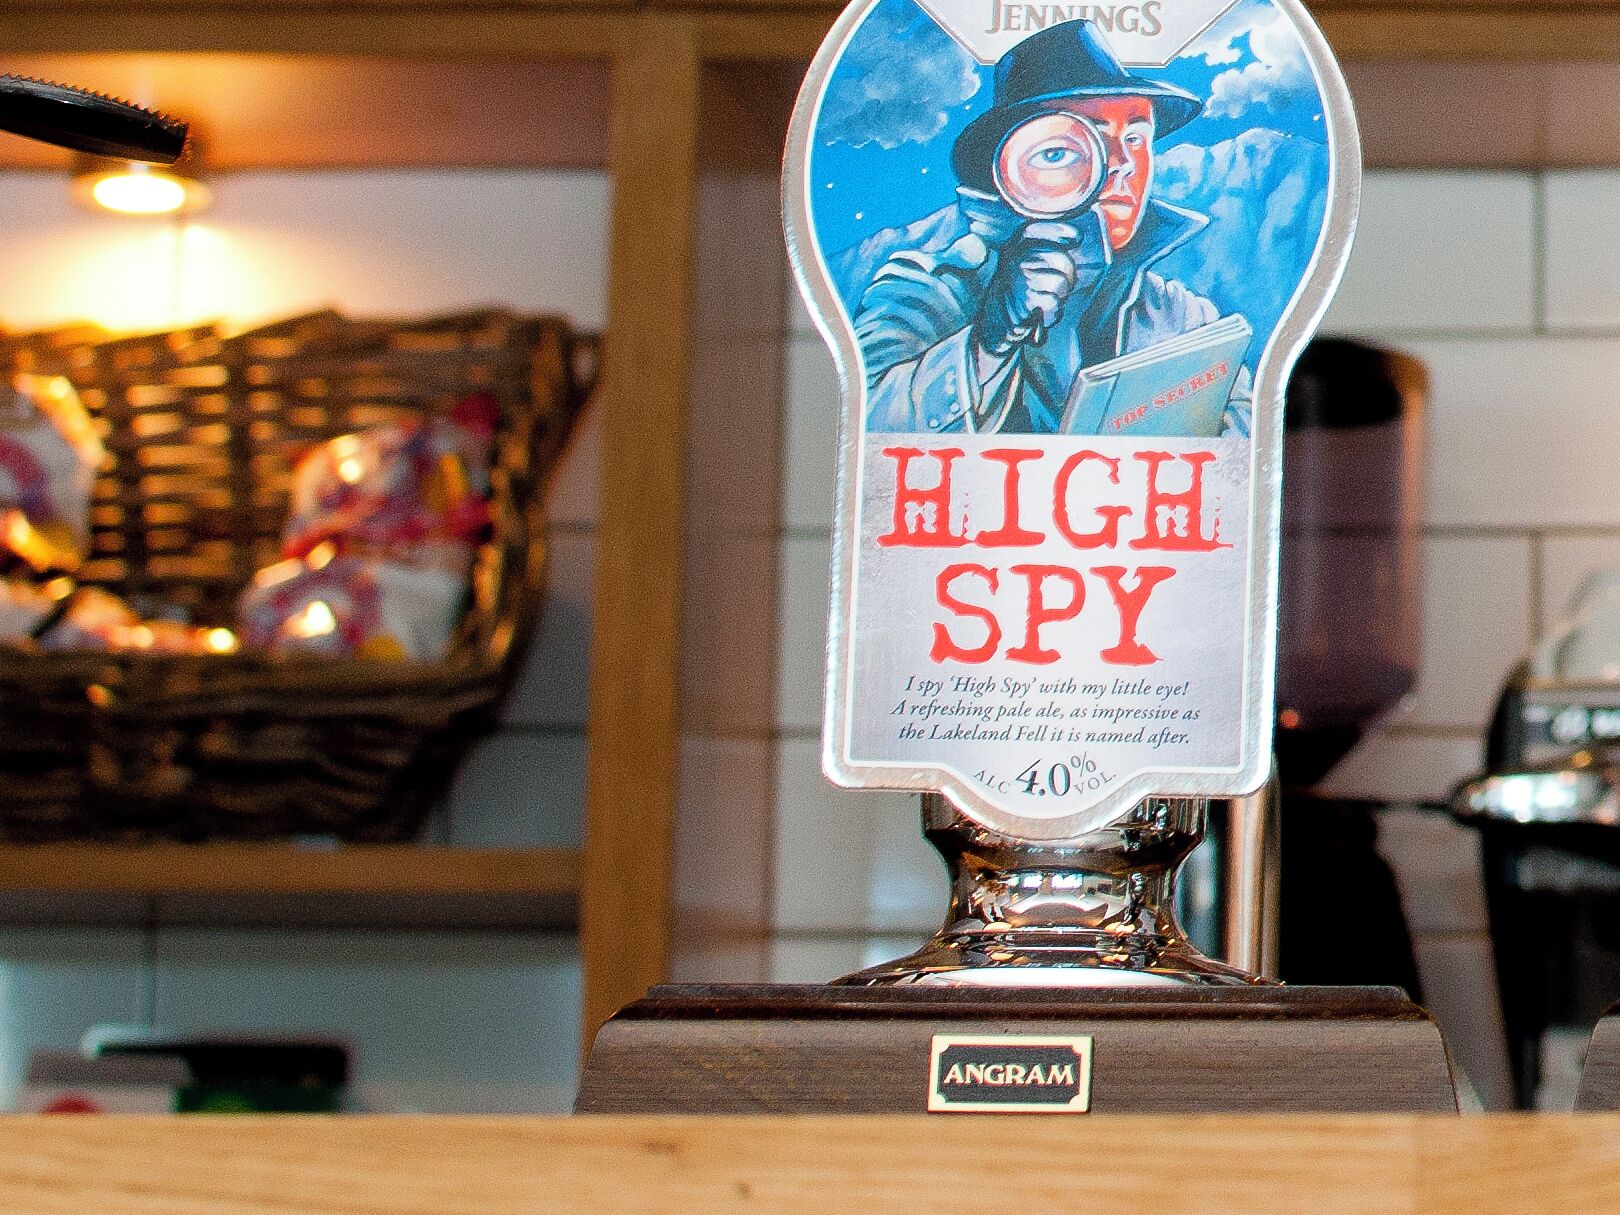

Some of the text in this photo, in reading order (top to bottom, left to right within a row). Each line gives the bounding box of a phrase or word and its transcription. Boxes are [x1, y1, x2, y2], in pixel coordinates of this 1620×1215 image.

[876, 446, 1235, 552] HIGH
[929, 562, 1178, 666] SPY
[904, 675, 916, 692] I
[917, 678, 943, 697] spy
[1039, 677, 1077, 694] with
[1081, 684, 1107, 700] my
[1111, 678, 1151, 695] little
[1155, 681, 1189, 701] eye!
[889, 699, 1200, 724] A refreshing pale ale, as impressive as
[898, 722, 1189, 749] the Lakeland Fell it is named after.
[974, 751, 1116, 796] ALC 4.0% VOL.
[944, 1063, 1075, 1086] ANGRAM
